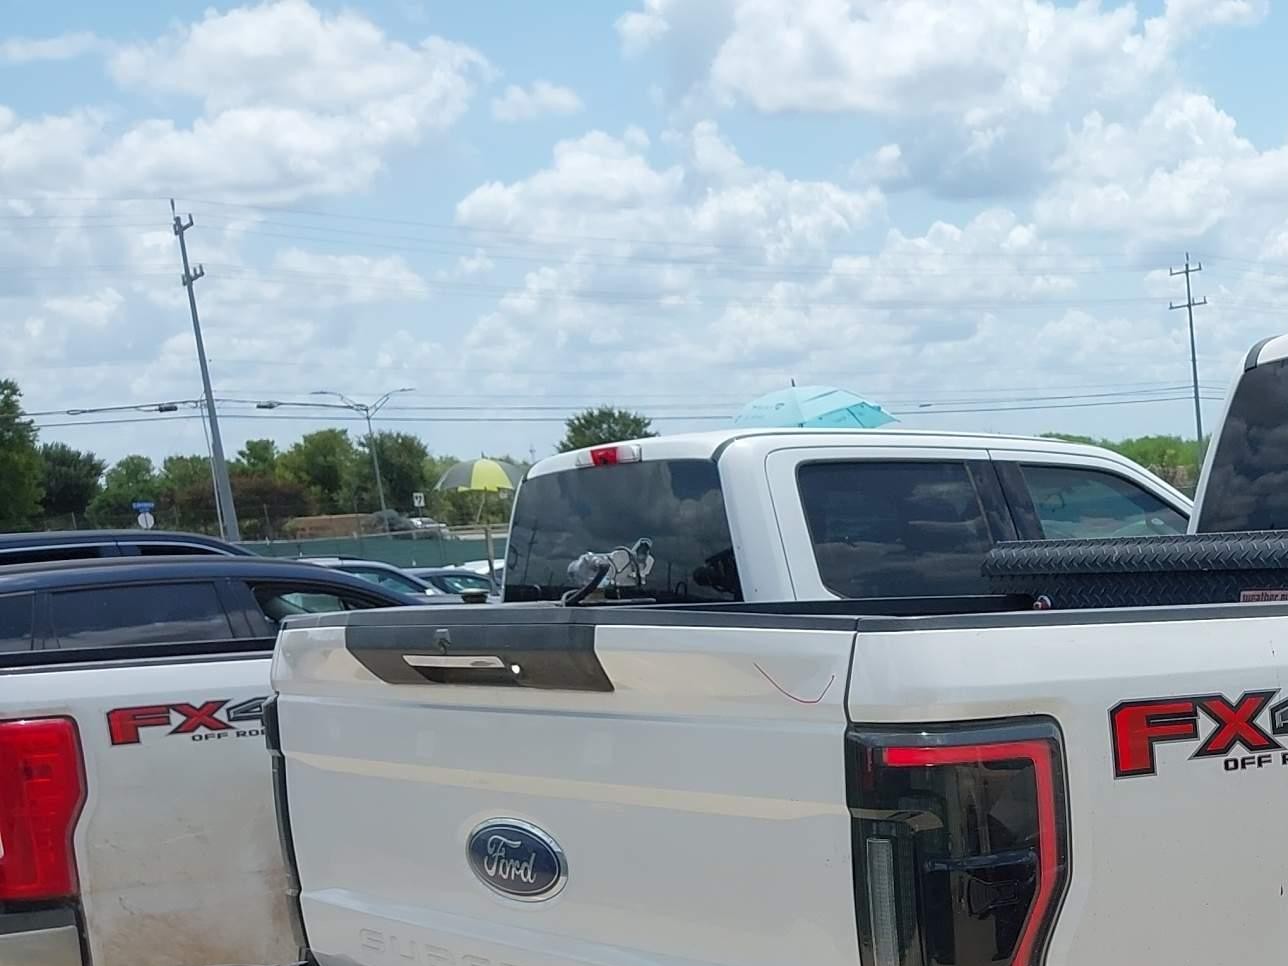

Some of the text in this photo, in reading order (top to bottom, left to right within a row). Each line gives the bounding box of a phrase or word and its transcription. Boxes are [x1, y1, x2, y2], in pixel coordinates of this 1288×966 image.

[106, 696, 268, 746] FX4
[191, 729, 266, 742] OFF RO
[1223, 754, 1273, 772] OFF
[483, 834, 537, 885] Ford
